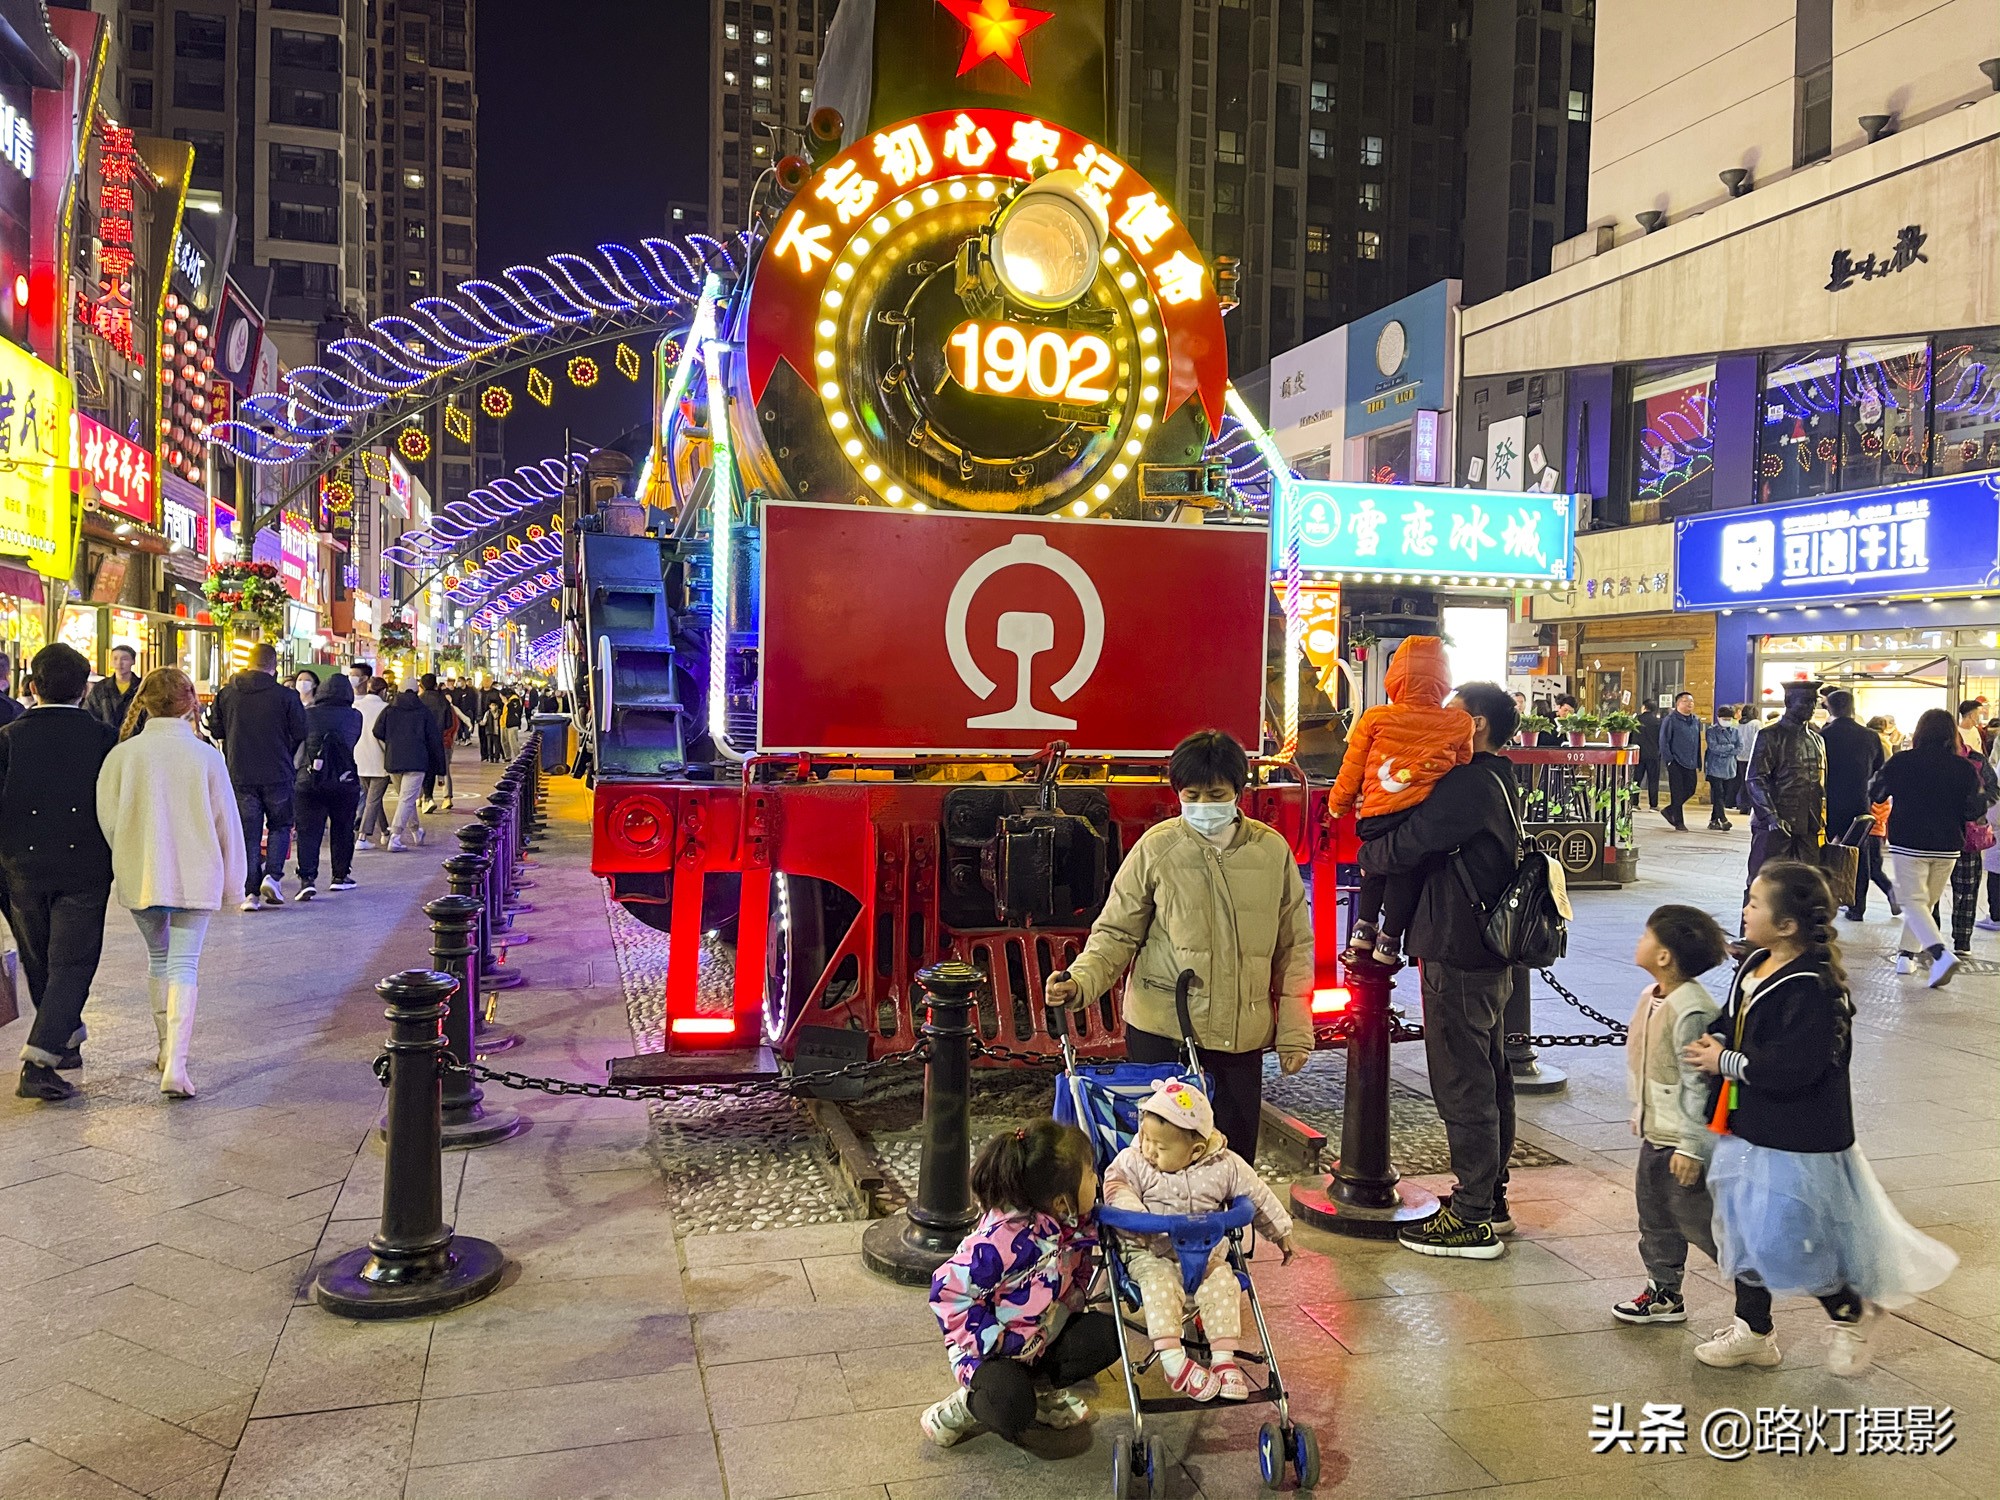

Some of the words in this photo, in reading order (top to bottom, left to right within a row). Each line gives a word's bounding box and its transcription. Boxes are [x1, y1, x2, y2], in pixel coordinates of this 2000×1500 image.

[773, 112, 1206, 307] 不忘初心牢记使命
[951, 323, 1110, 403] 1902
[1489, 436, 1519, 482] 發
[1347, 498, 1548, 569] 雪恋冰城
[1566, 752, 1586, 762] 902
